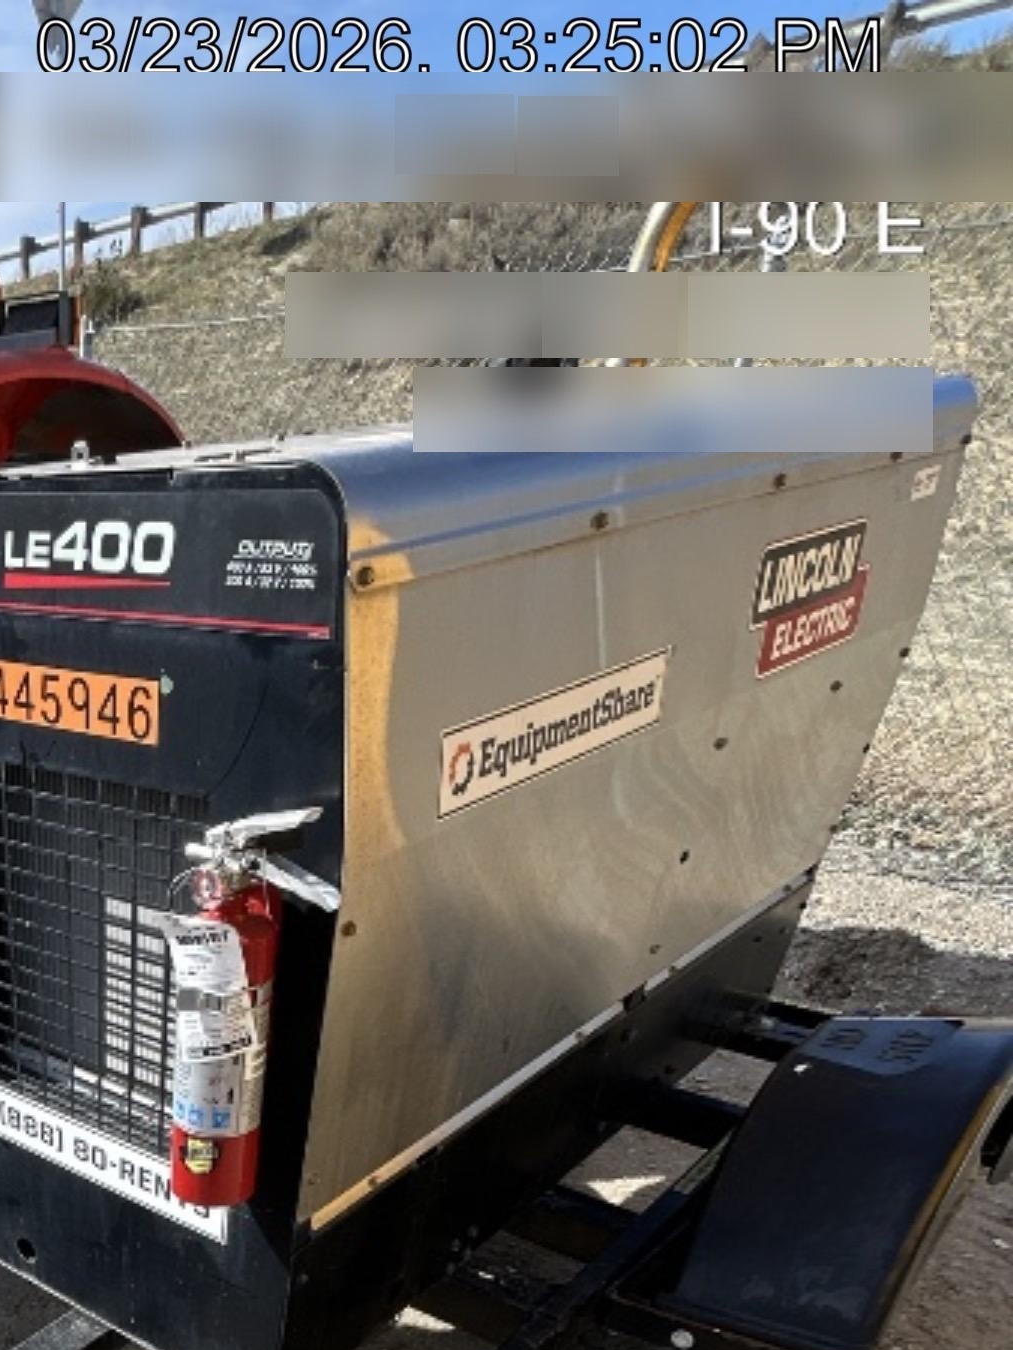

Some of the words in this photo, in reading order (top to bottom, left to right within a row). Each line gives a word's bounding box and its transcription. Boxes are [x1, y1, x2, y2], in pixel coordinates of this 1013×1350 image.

[3, 519, 176, 575] LE400
[757, 533, 862, 613] LINCOLN
[770, 596, 856, 661] ELECTRIC
[478, 680, 656, 778] EquipmentShare
[73, 1136, 210, 1218] 80-REN
